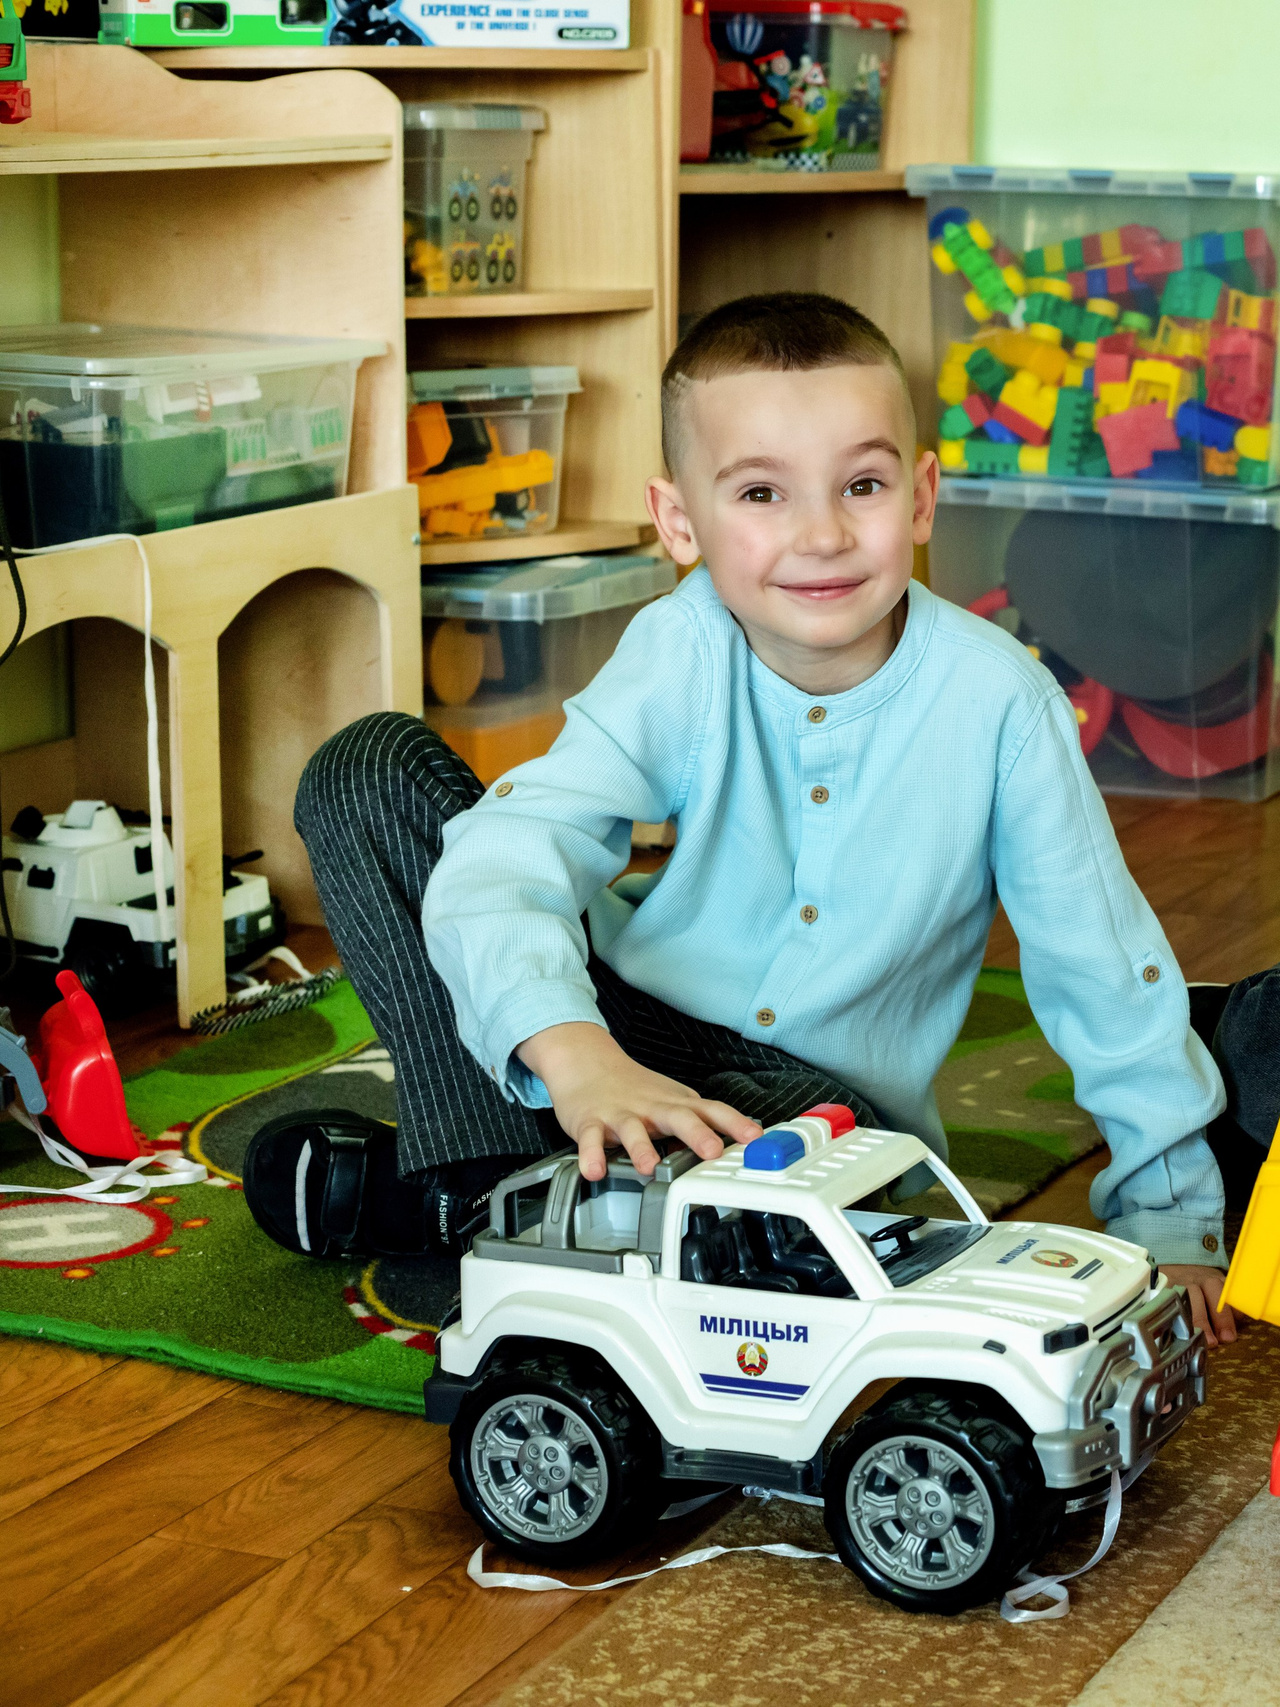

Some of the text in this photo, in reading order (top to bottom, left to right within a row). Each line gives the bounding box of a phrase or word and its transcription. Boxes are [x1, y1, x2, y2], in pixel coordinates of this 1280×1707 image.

[421, 4, 490, 16] EXPERIENCE
[472, 1189, 494, 1209] FASH
[700, 1315, 808, 1343] МІЛІЦЫЯ
